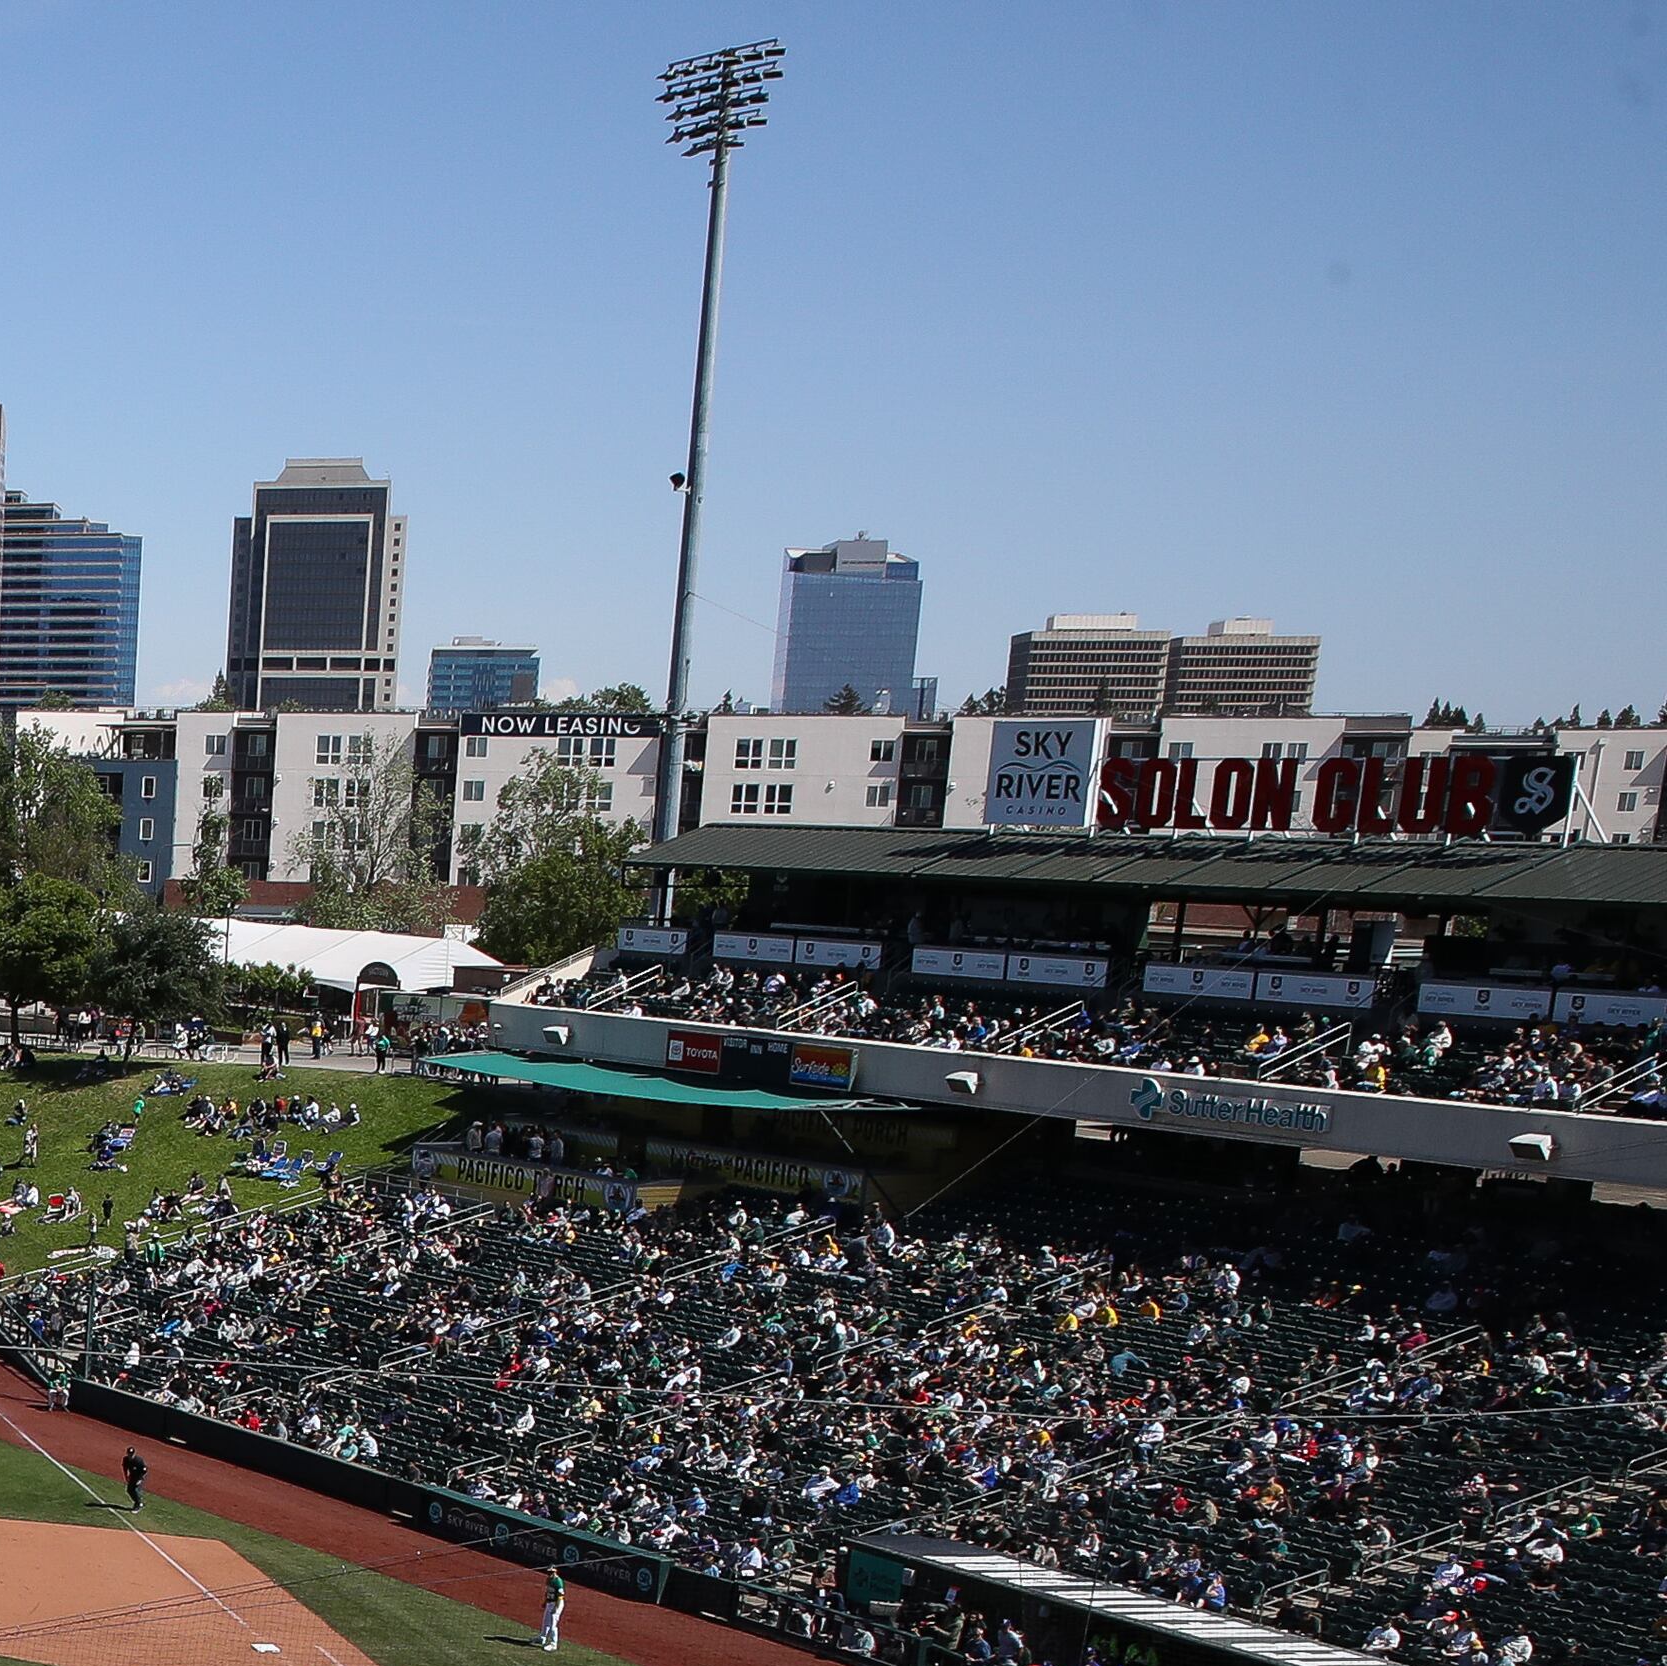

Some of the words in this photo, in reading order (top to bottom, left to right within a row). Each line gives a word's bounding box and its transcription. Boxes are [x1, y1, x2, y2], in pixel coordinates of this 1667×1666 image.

[480, 716, 537, 734] NOW
[543, 716, 641, 735] LEASING
[1014, 730, 1072, 759] SKY
[995, 774, 1081, 802] RIVER
[1097, 756, 1298, 834] SOLON
[1312, 756, 1496, 837] CLUB
[1005, 806, 1067, 816] CASINO
[685, 1046, 718, 1060] TOYOTA
[768, 1042, 788, 1054] HOME
[791, 1057, 832, 1078] Surfside
[1168, 1089, 1244, 1123] Sutter
[1246, 1096, 1327, 1133] Health
[457, 1158, 524, 1190] PACIFICO
[734, 1156, 809, 1187] PACIFICO
[447, 1514, 465, 1527] SKY
[466, 1519, 490, 1536] RIVER
[514, 1537, 531, 1550] SKY
[532, 1542, 558, 1559] RIVER
[603, 1565, 631, 1583] RIVER
